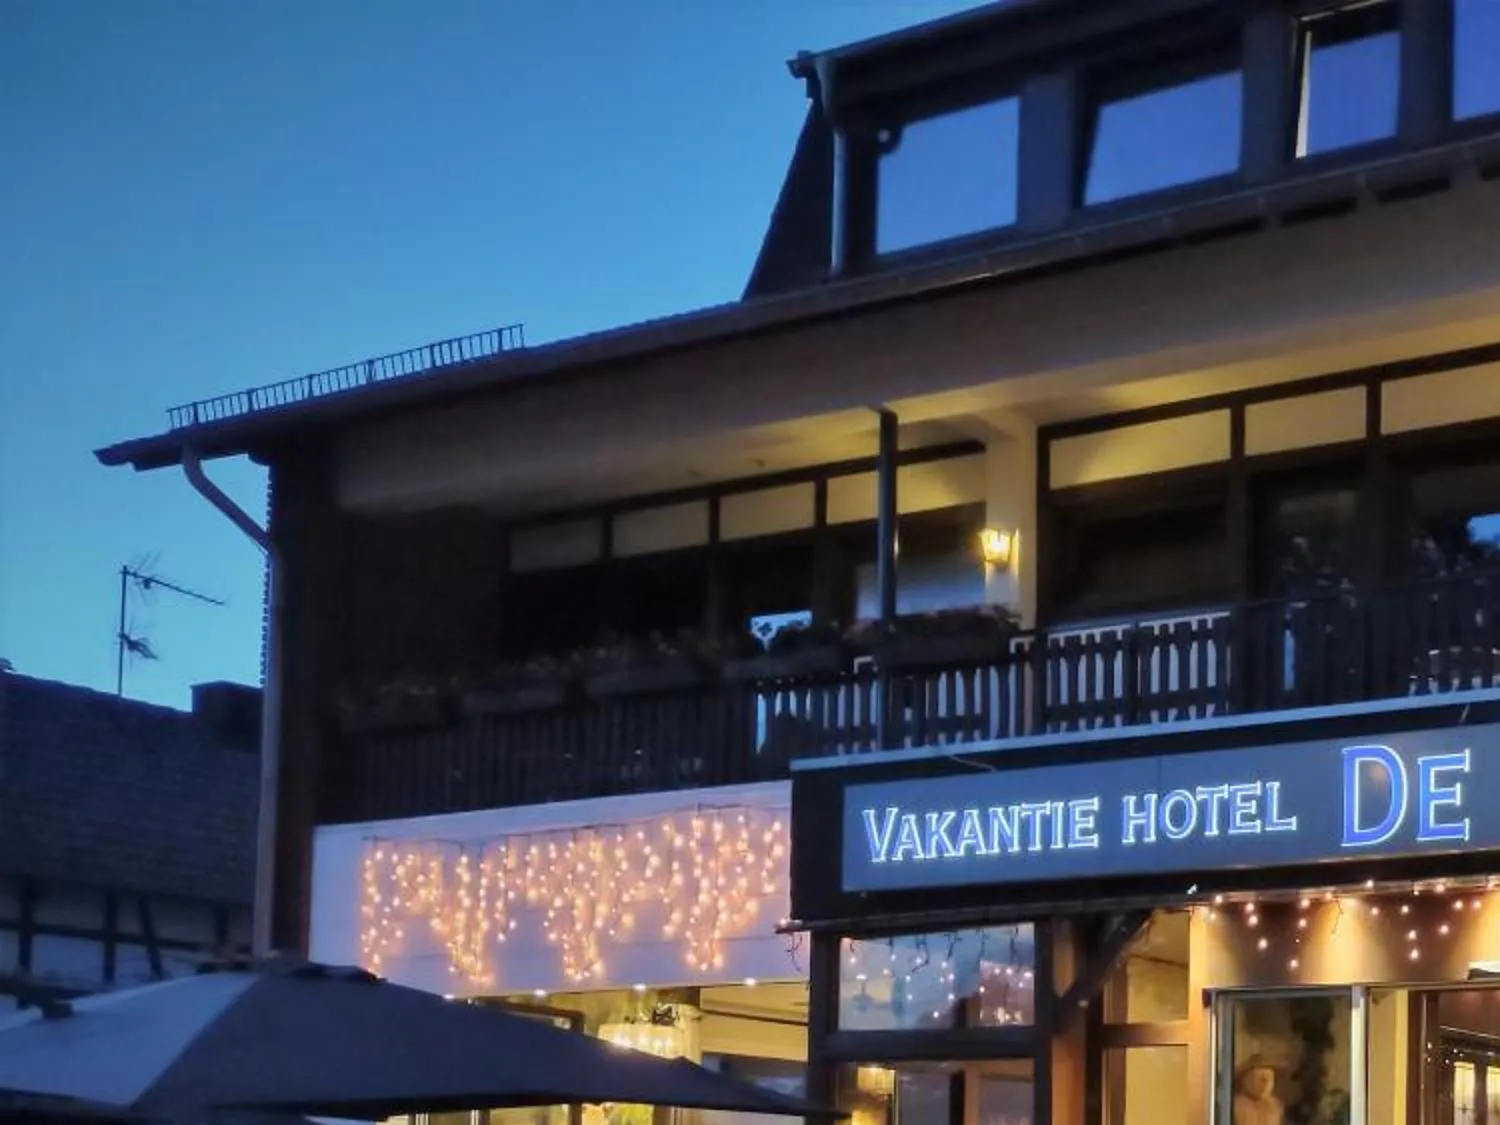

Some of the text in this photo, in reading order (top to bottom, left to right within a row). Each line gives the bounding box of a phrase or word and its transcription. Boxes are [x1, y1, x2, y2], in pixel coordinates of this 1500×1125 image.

[862, 797, 1099, 863] VAKANTIE
[1121, 781, 1298, 846] HOTEL
[1340, 744, 1472, 847] DE
